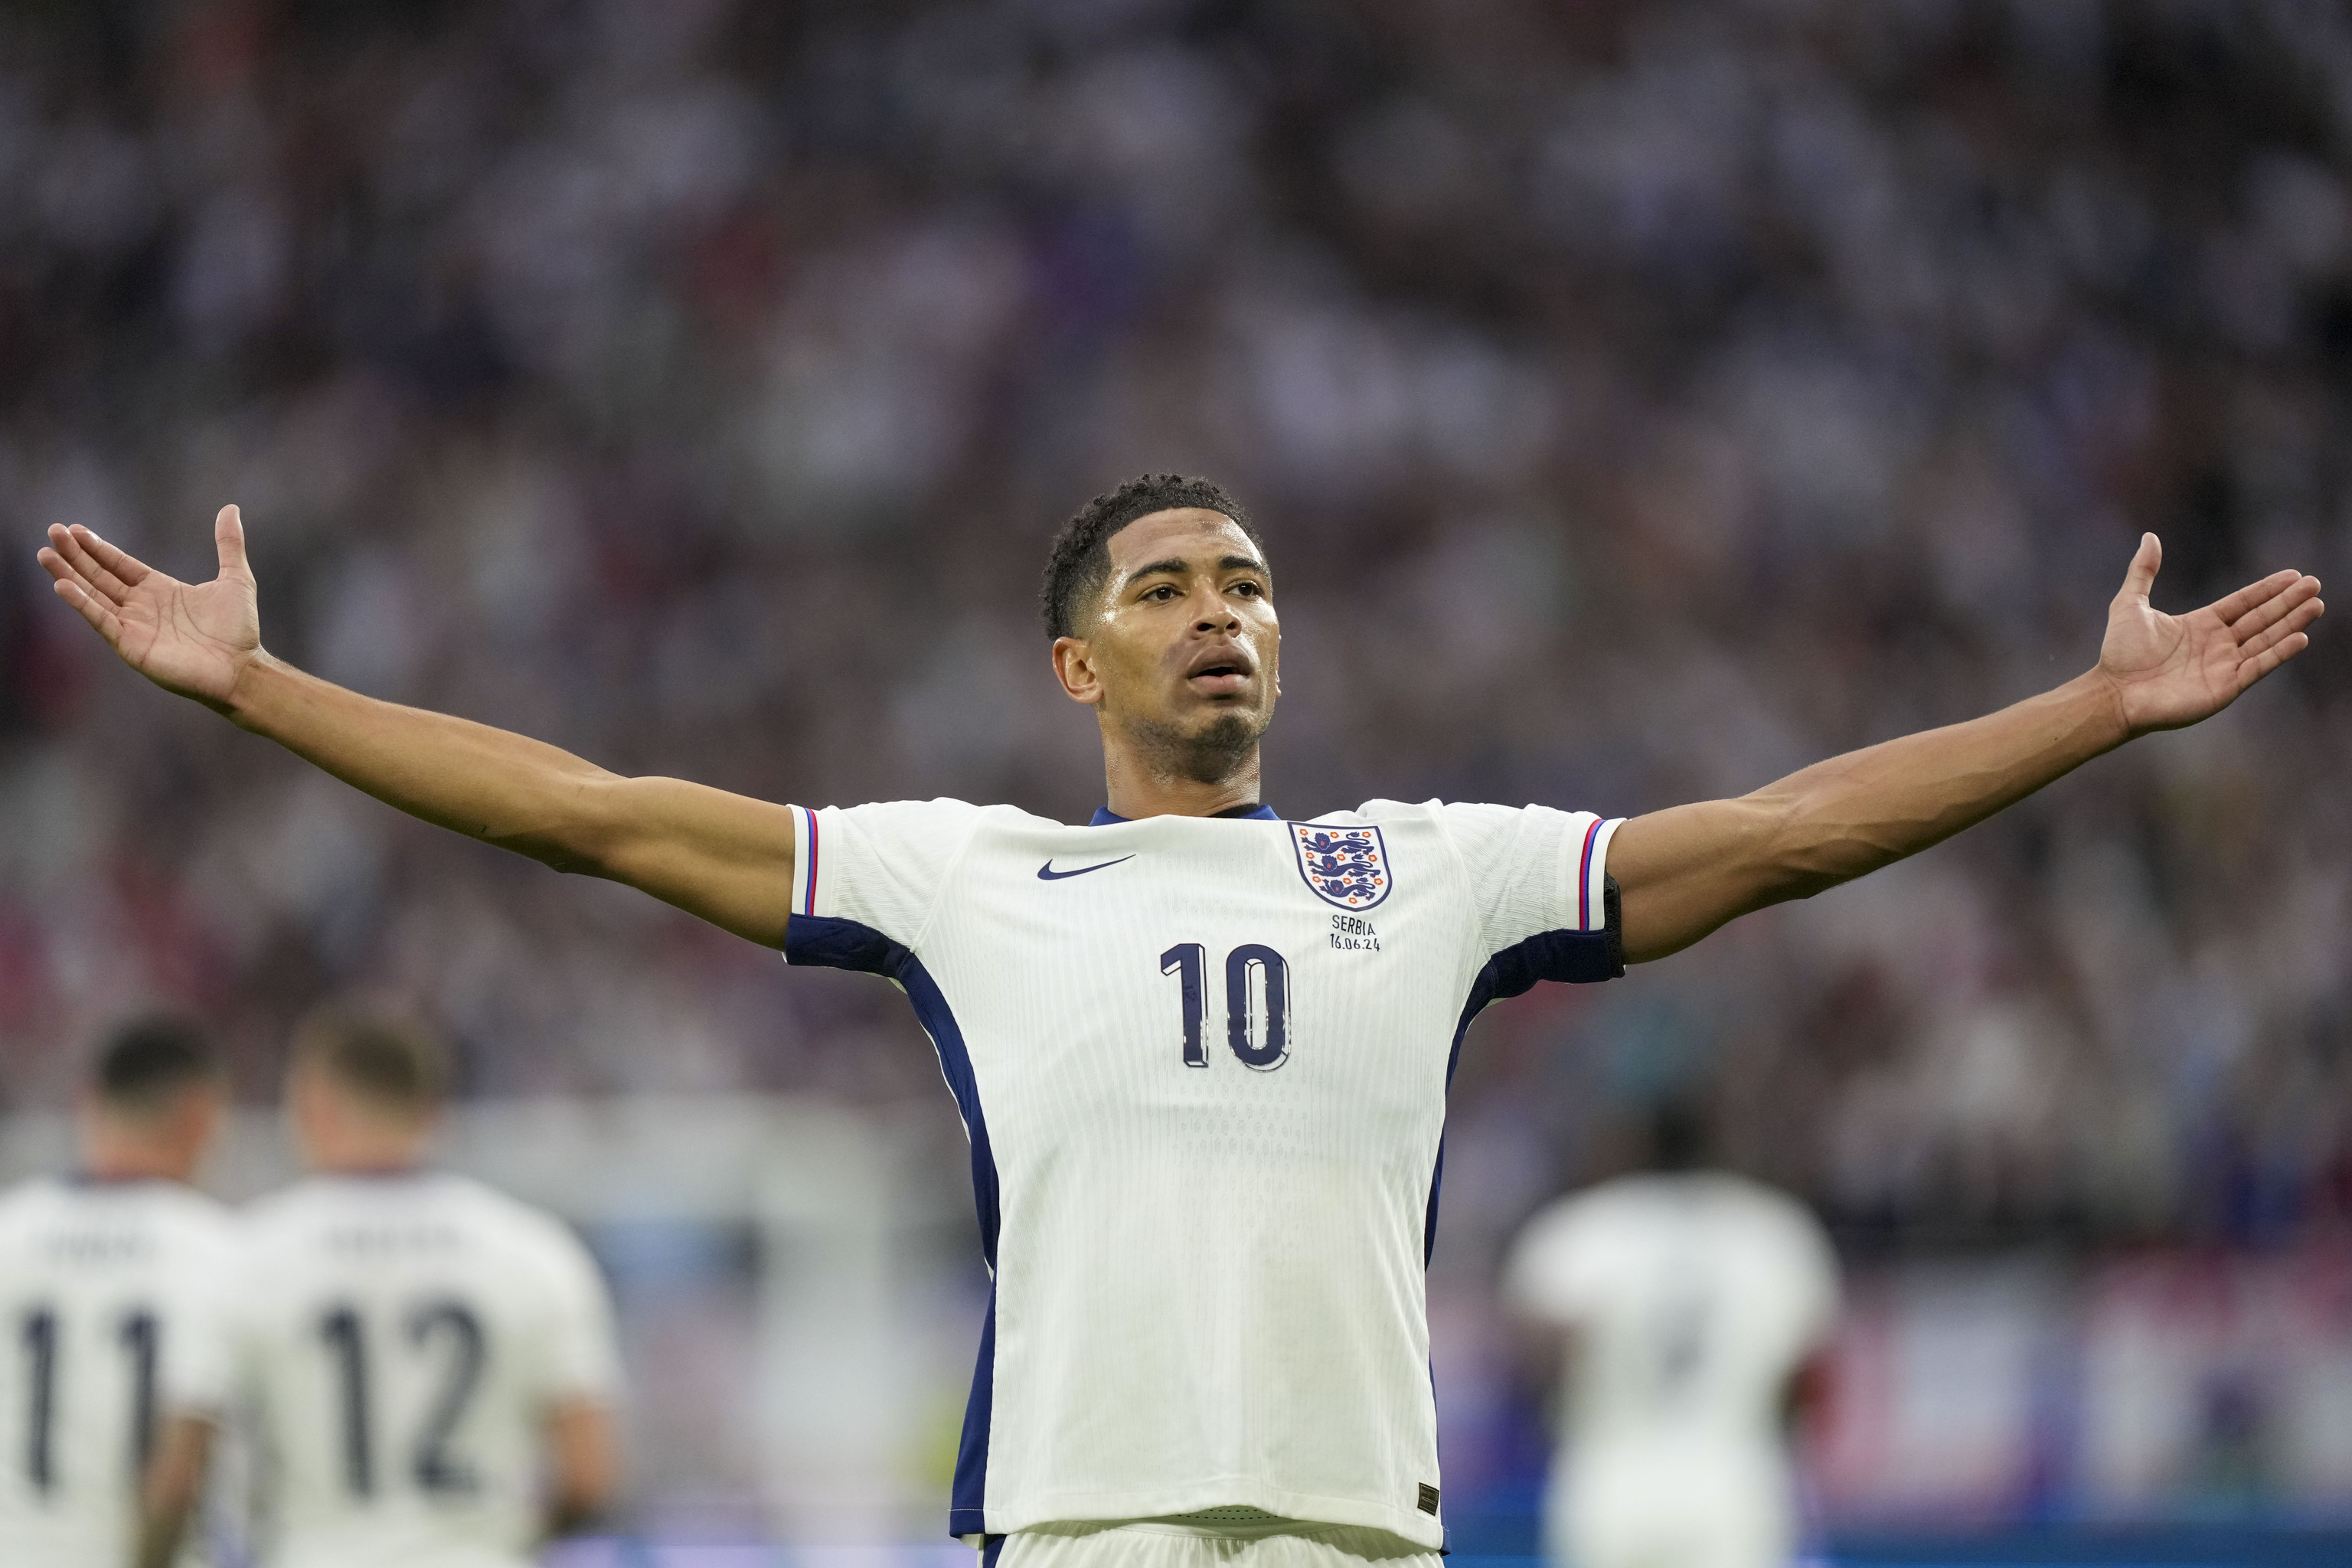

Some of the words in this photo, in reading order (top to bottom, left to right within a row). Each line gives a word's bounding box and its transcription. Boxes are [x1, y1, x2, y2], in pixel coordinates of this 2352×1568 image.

[1330, 933, 1380, 952] 16.06.24
[1331, 914, 1376, 936] SERBIA
[1160, 942, 1292, 1073] 10
[18, 1303, 161, 1495] 11
[314, 1298, 492, 1497] 12
